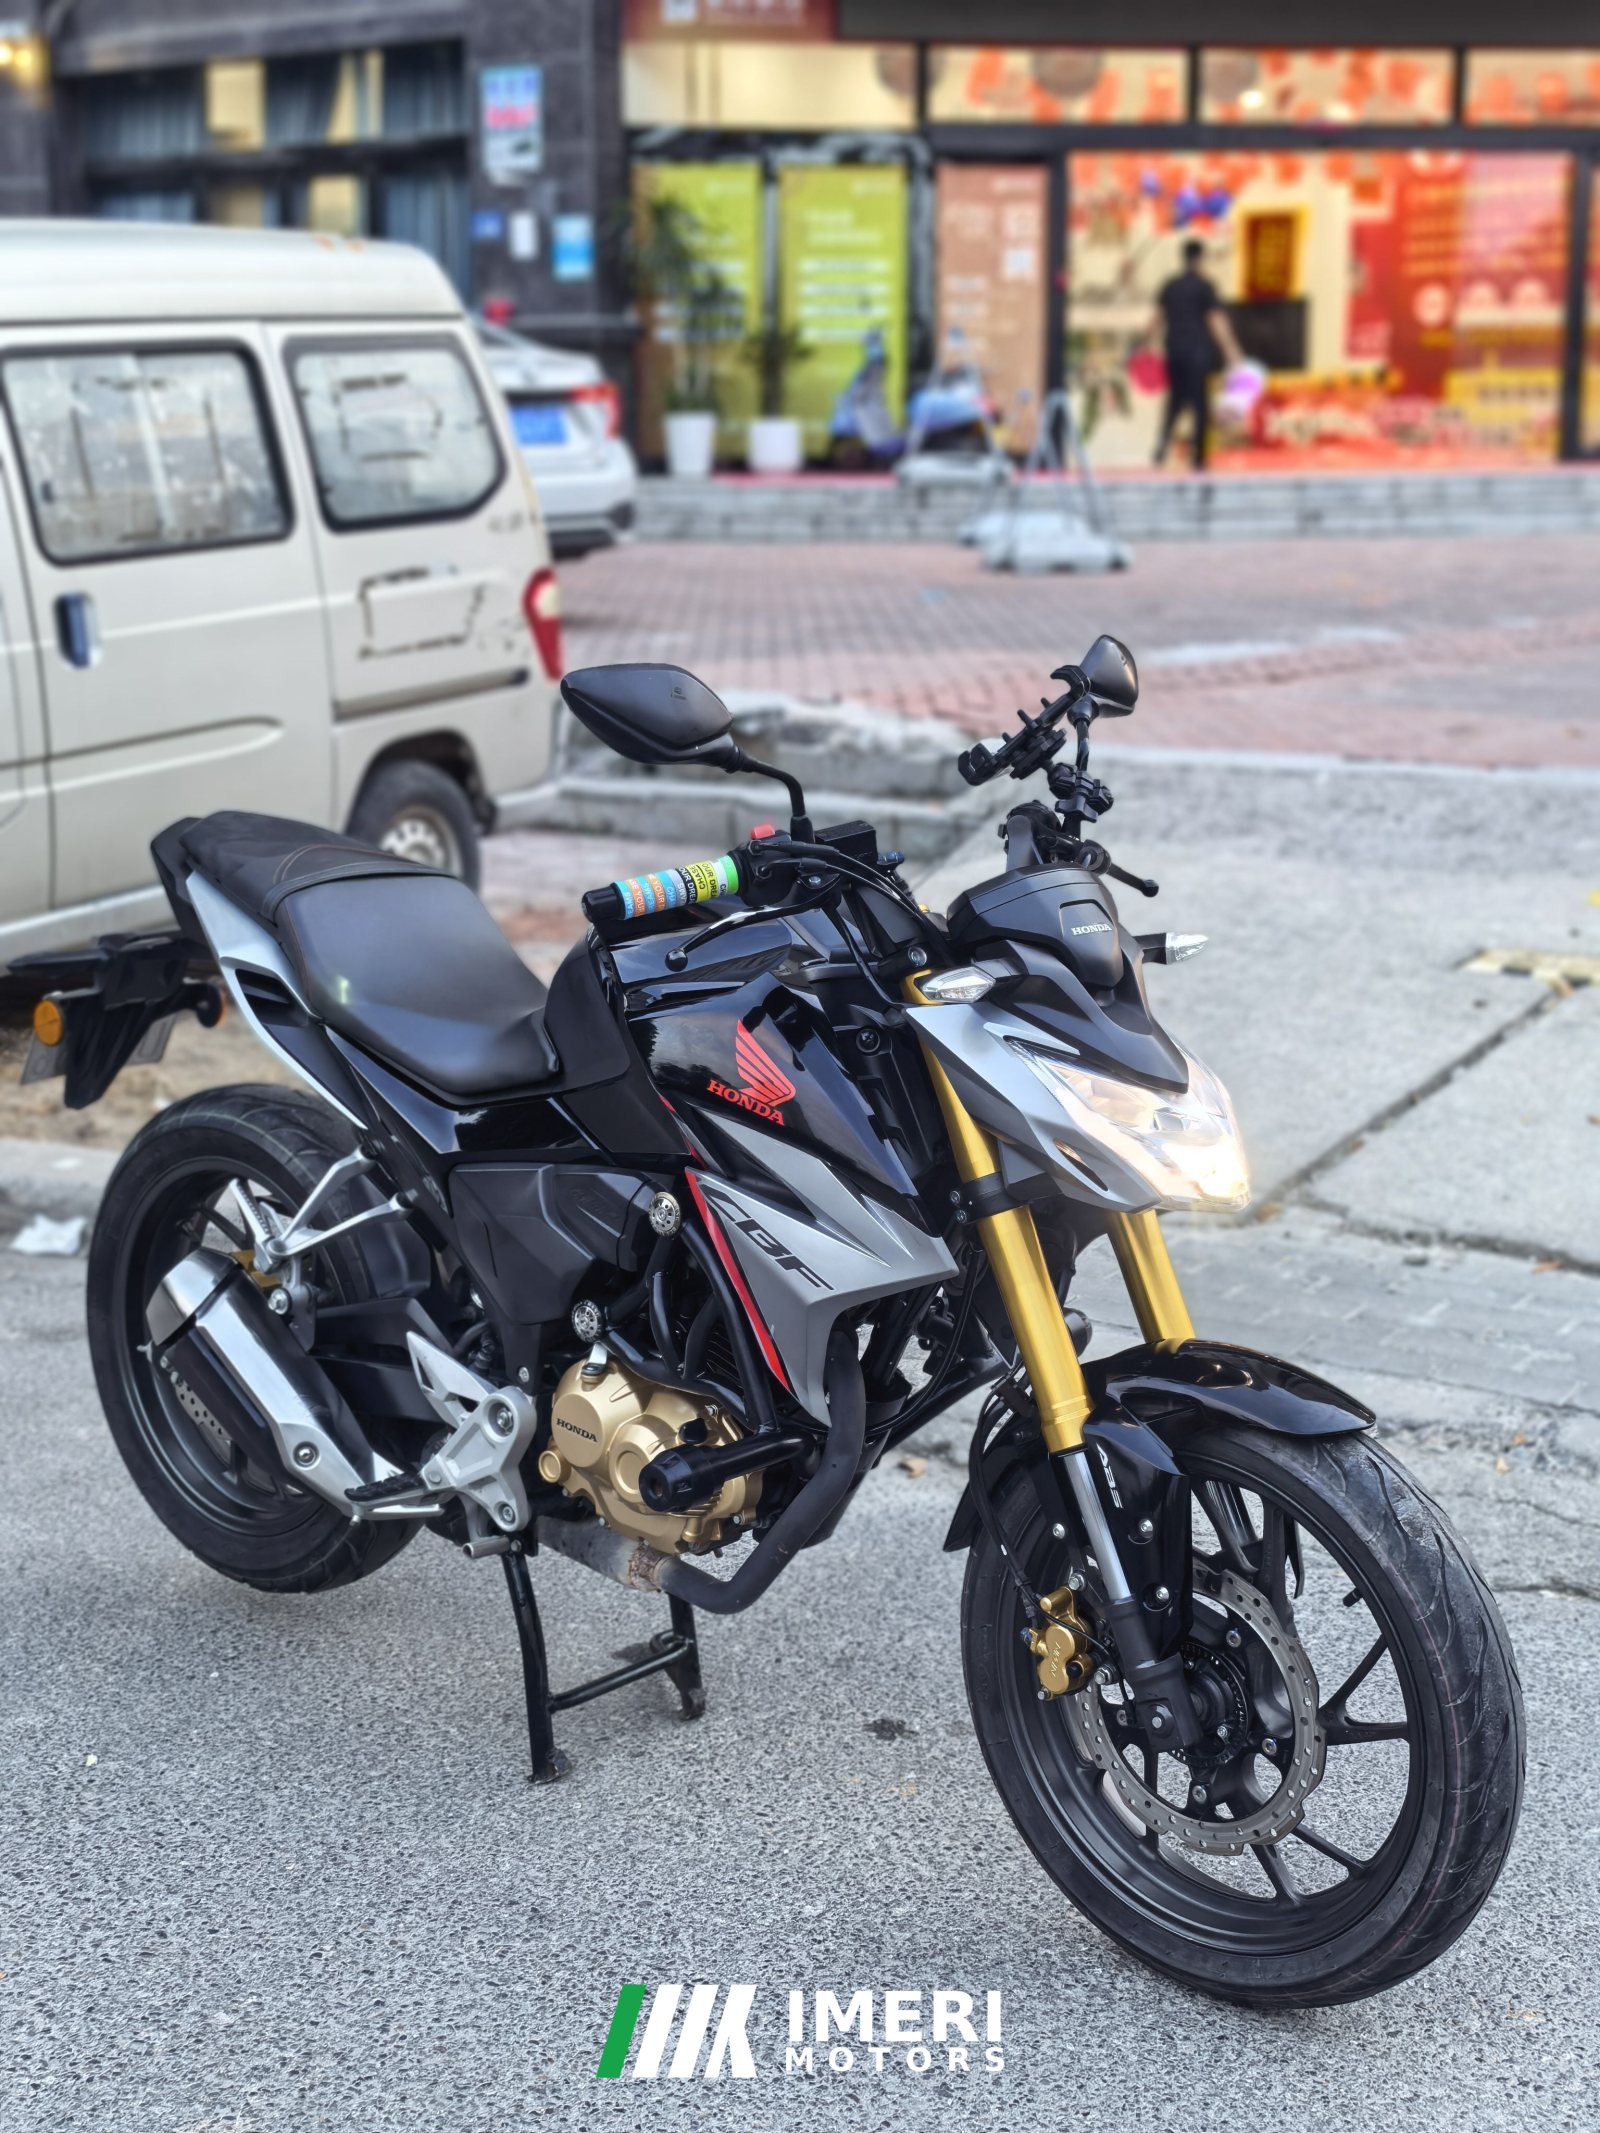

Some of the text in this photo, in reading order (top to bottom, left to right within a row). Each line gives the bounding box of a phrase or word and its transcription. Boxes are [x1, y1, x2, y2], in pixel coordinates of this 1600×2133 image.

[690, 866, 706, 890] CHASE
[1071, 923, 1112, 936] HONDA
[706, 1079, 785, 1127] HONDA
[697, 1183, 835, 1291] CBF
[556, 1418, 598, 1443] HONDA
[1096, 1442, 1123, 1509] ABS
